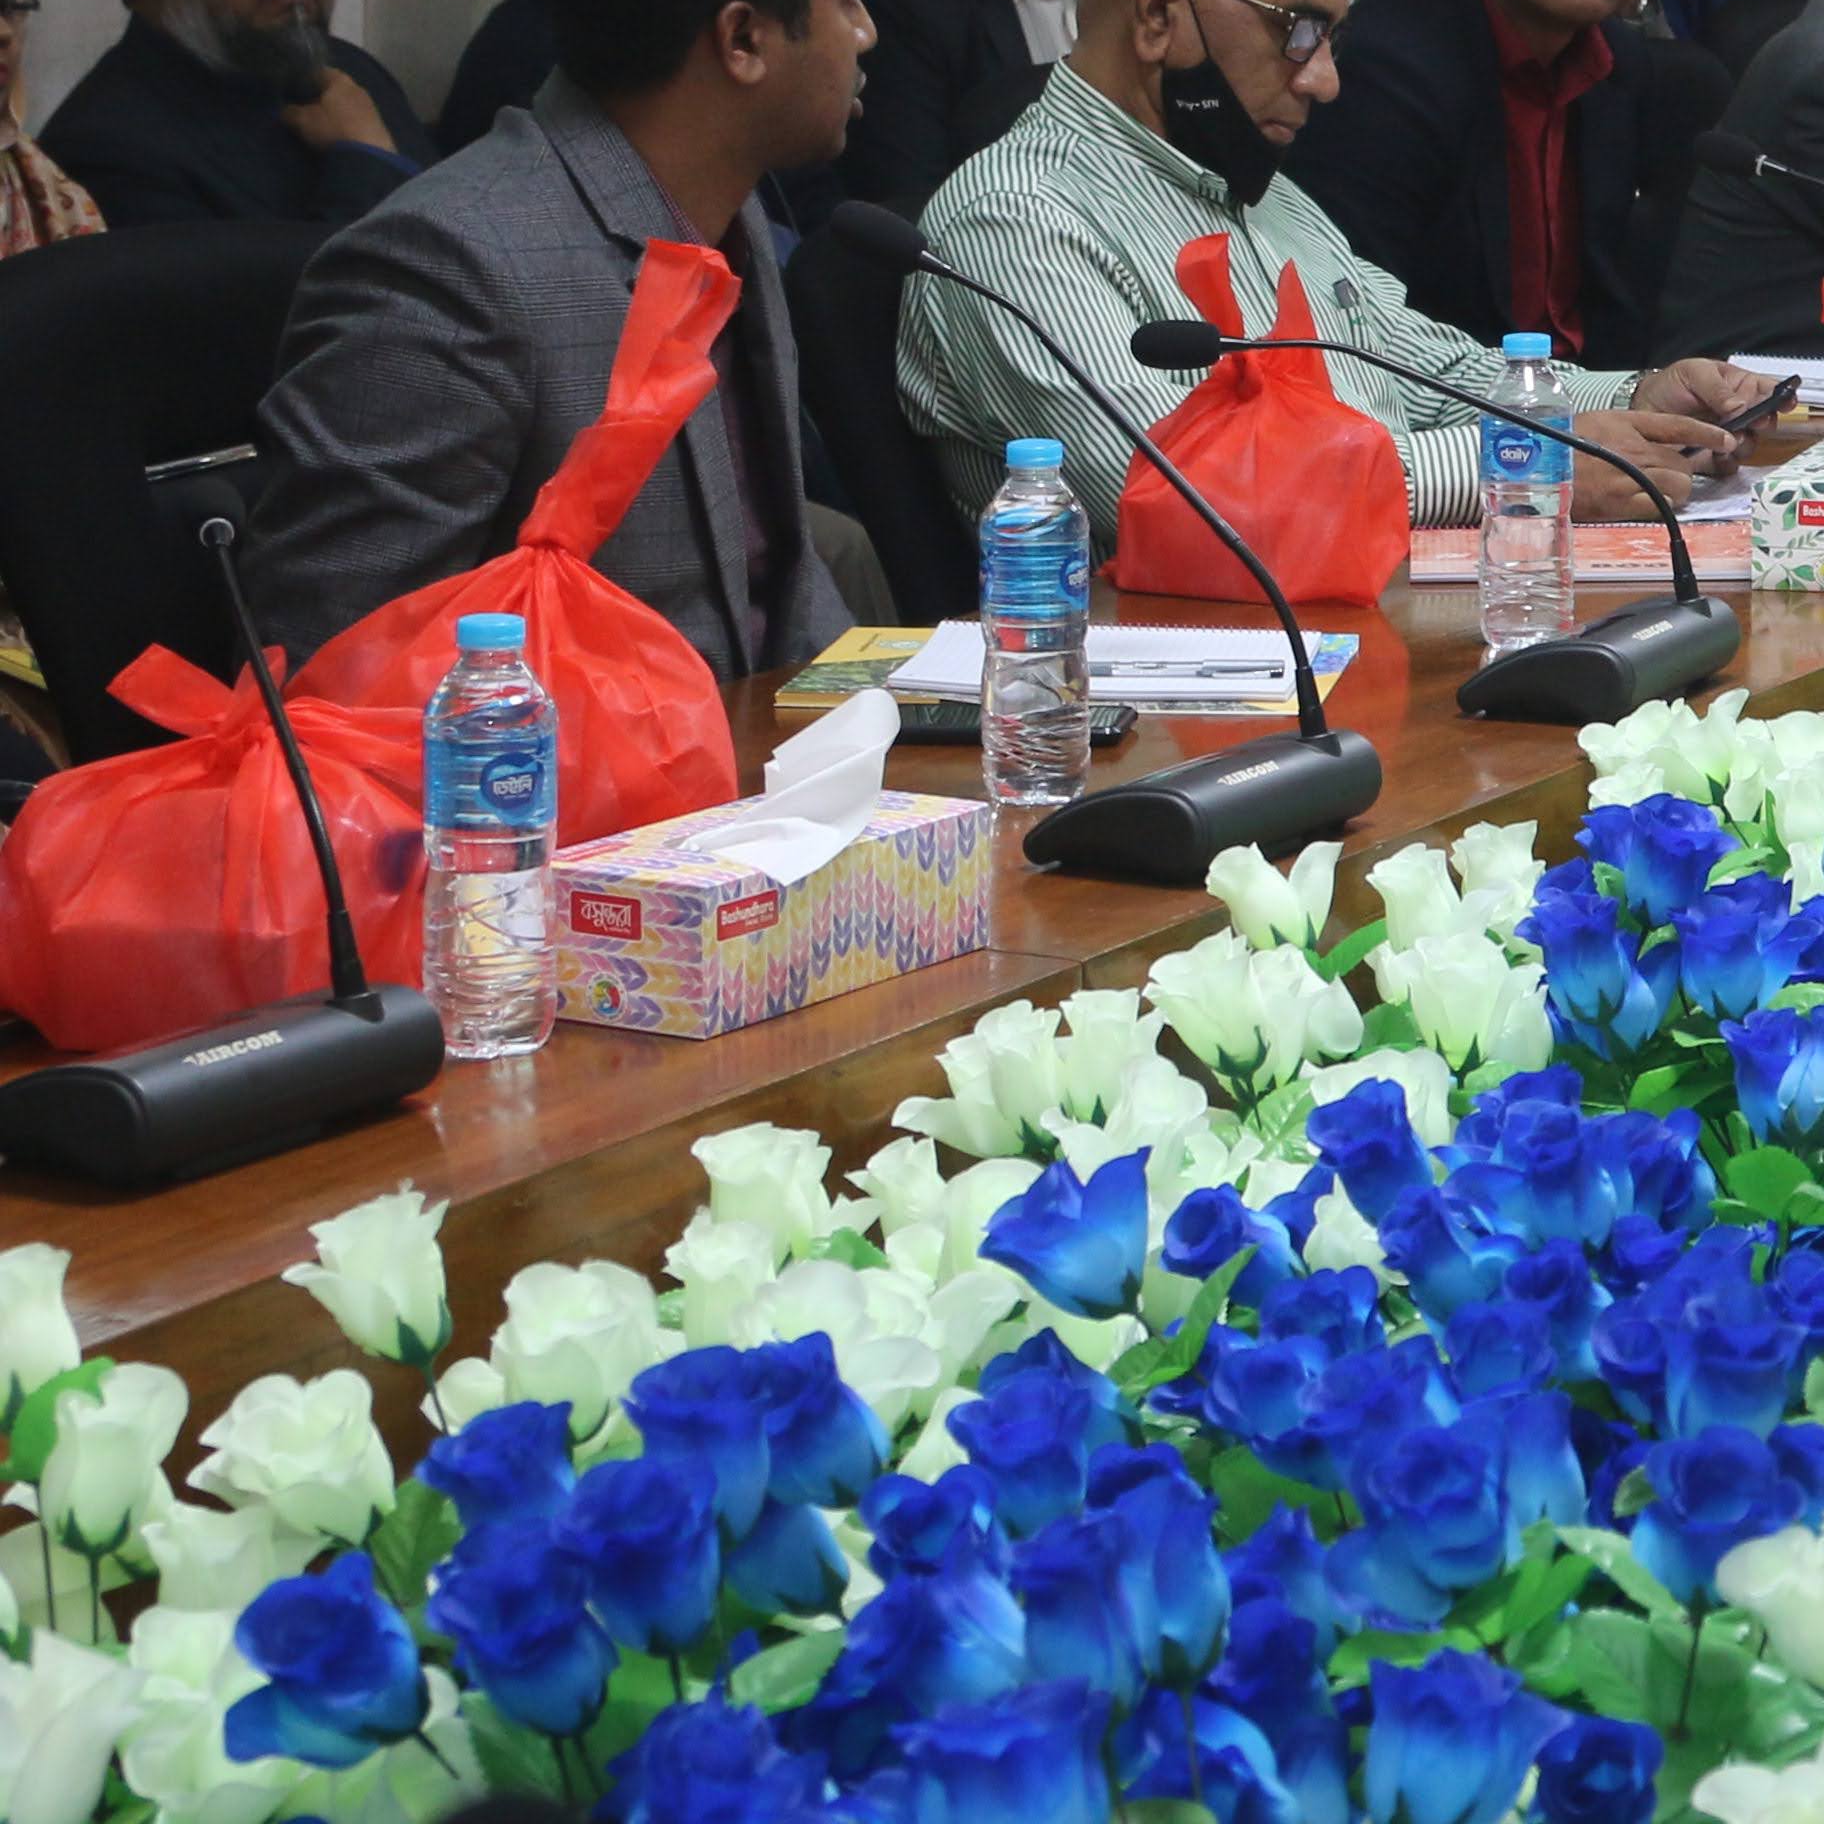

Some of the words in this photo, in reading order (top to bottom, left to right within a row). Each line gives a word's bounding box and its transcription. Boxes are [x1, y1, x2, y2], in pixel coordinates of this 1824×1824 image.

[1500, 447, 1531, 463] daily
[721, 900, 775, 926] Bashundhara
[194, 1029, 284, 1066] AIRCOM
